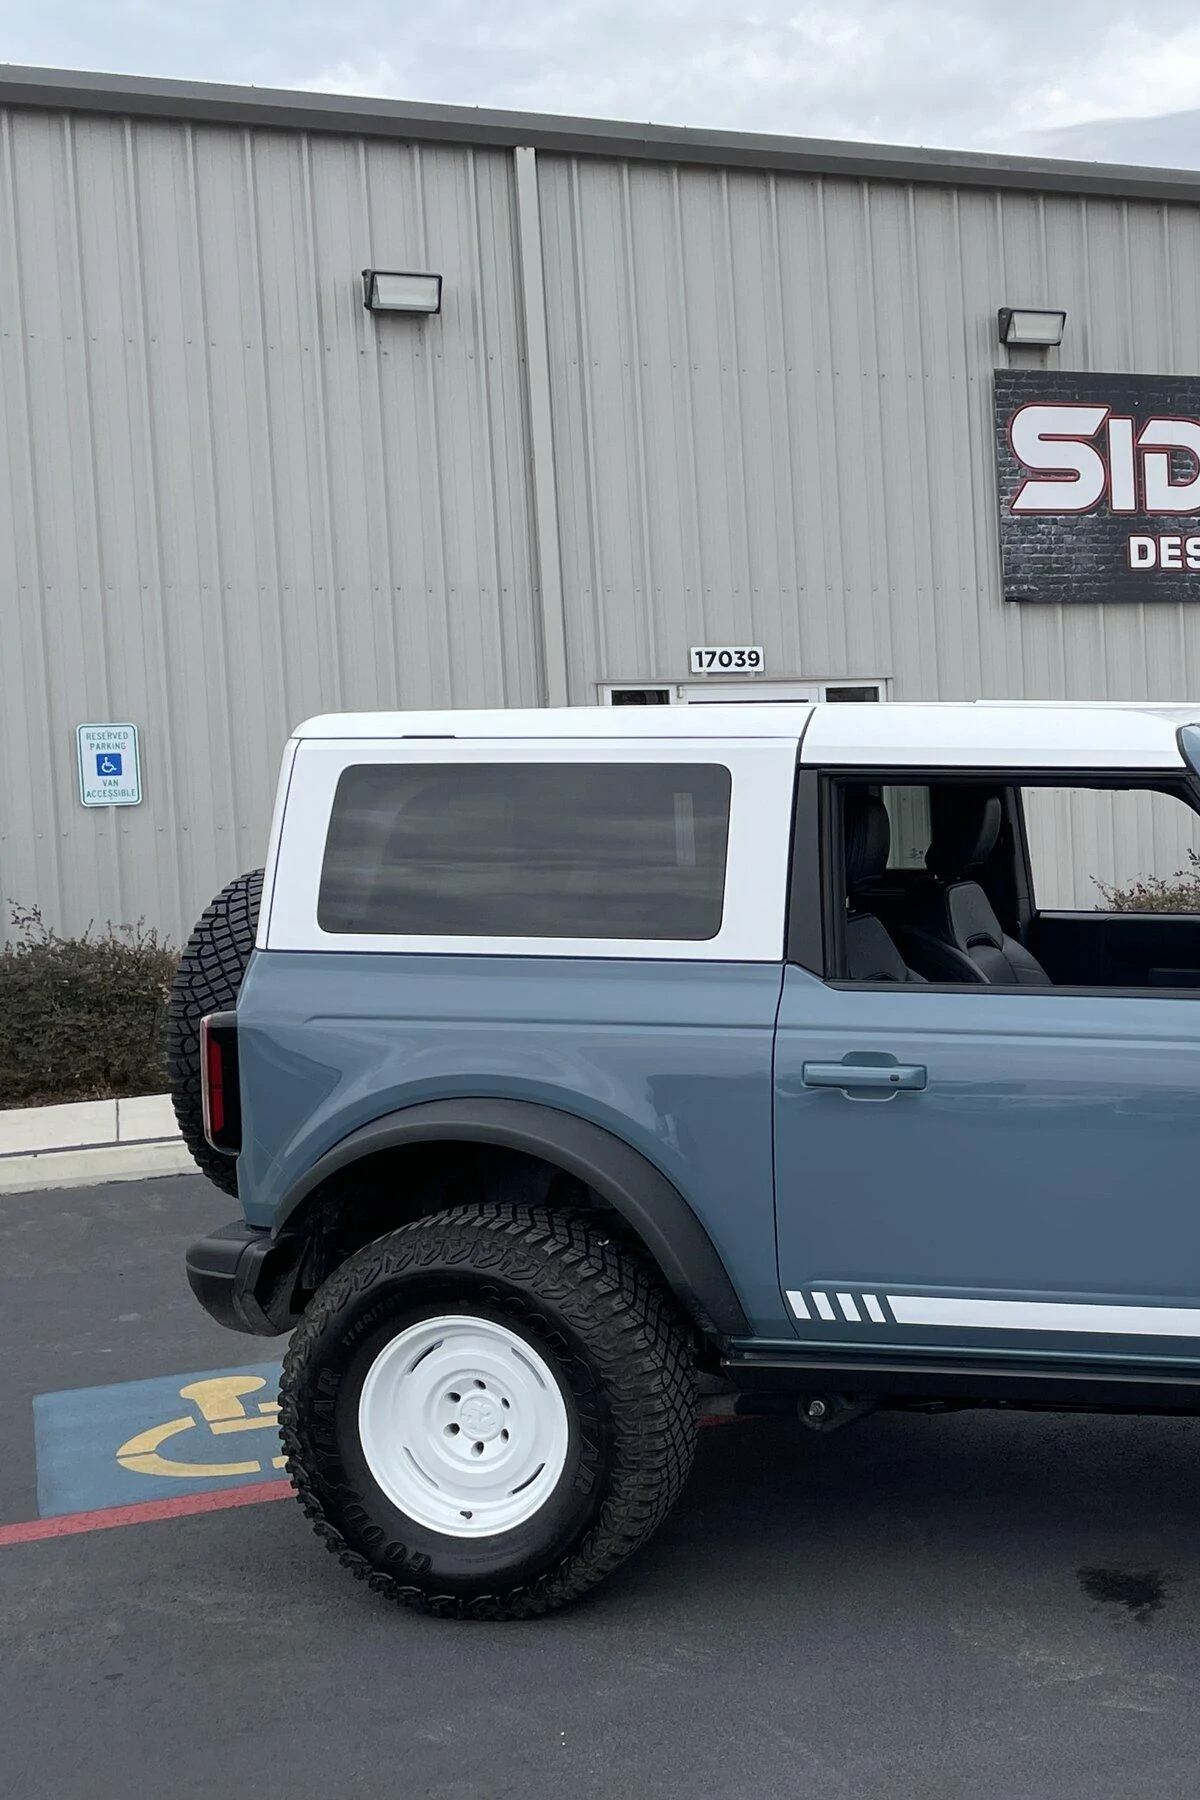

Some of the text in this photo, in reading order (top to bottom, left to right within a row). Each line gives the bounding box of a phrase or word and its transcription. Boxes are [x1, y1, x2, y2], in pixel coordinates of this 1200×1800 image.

[694, 650, 760, 668] 17039
[86, 732, 129, 740] RESERVED
[86, 789, 136, 798] ACCESSIBLE
